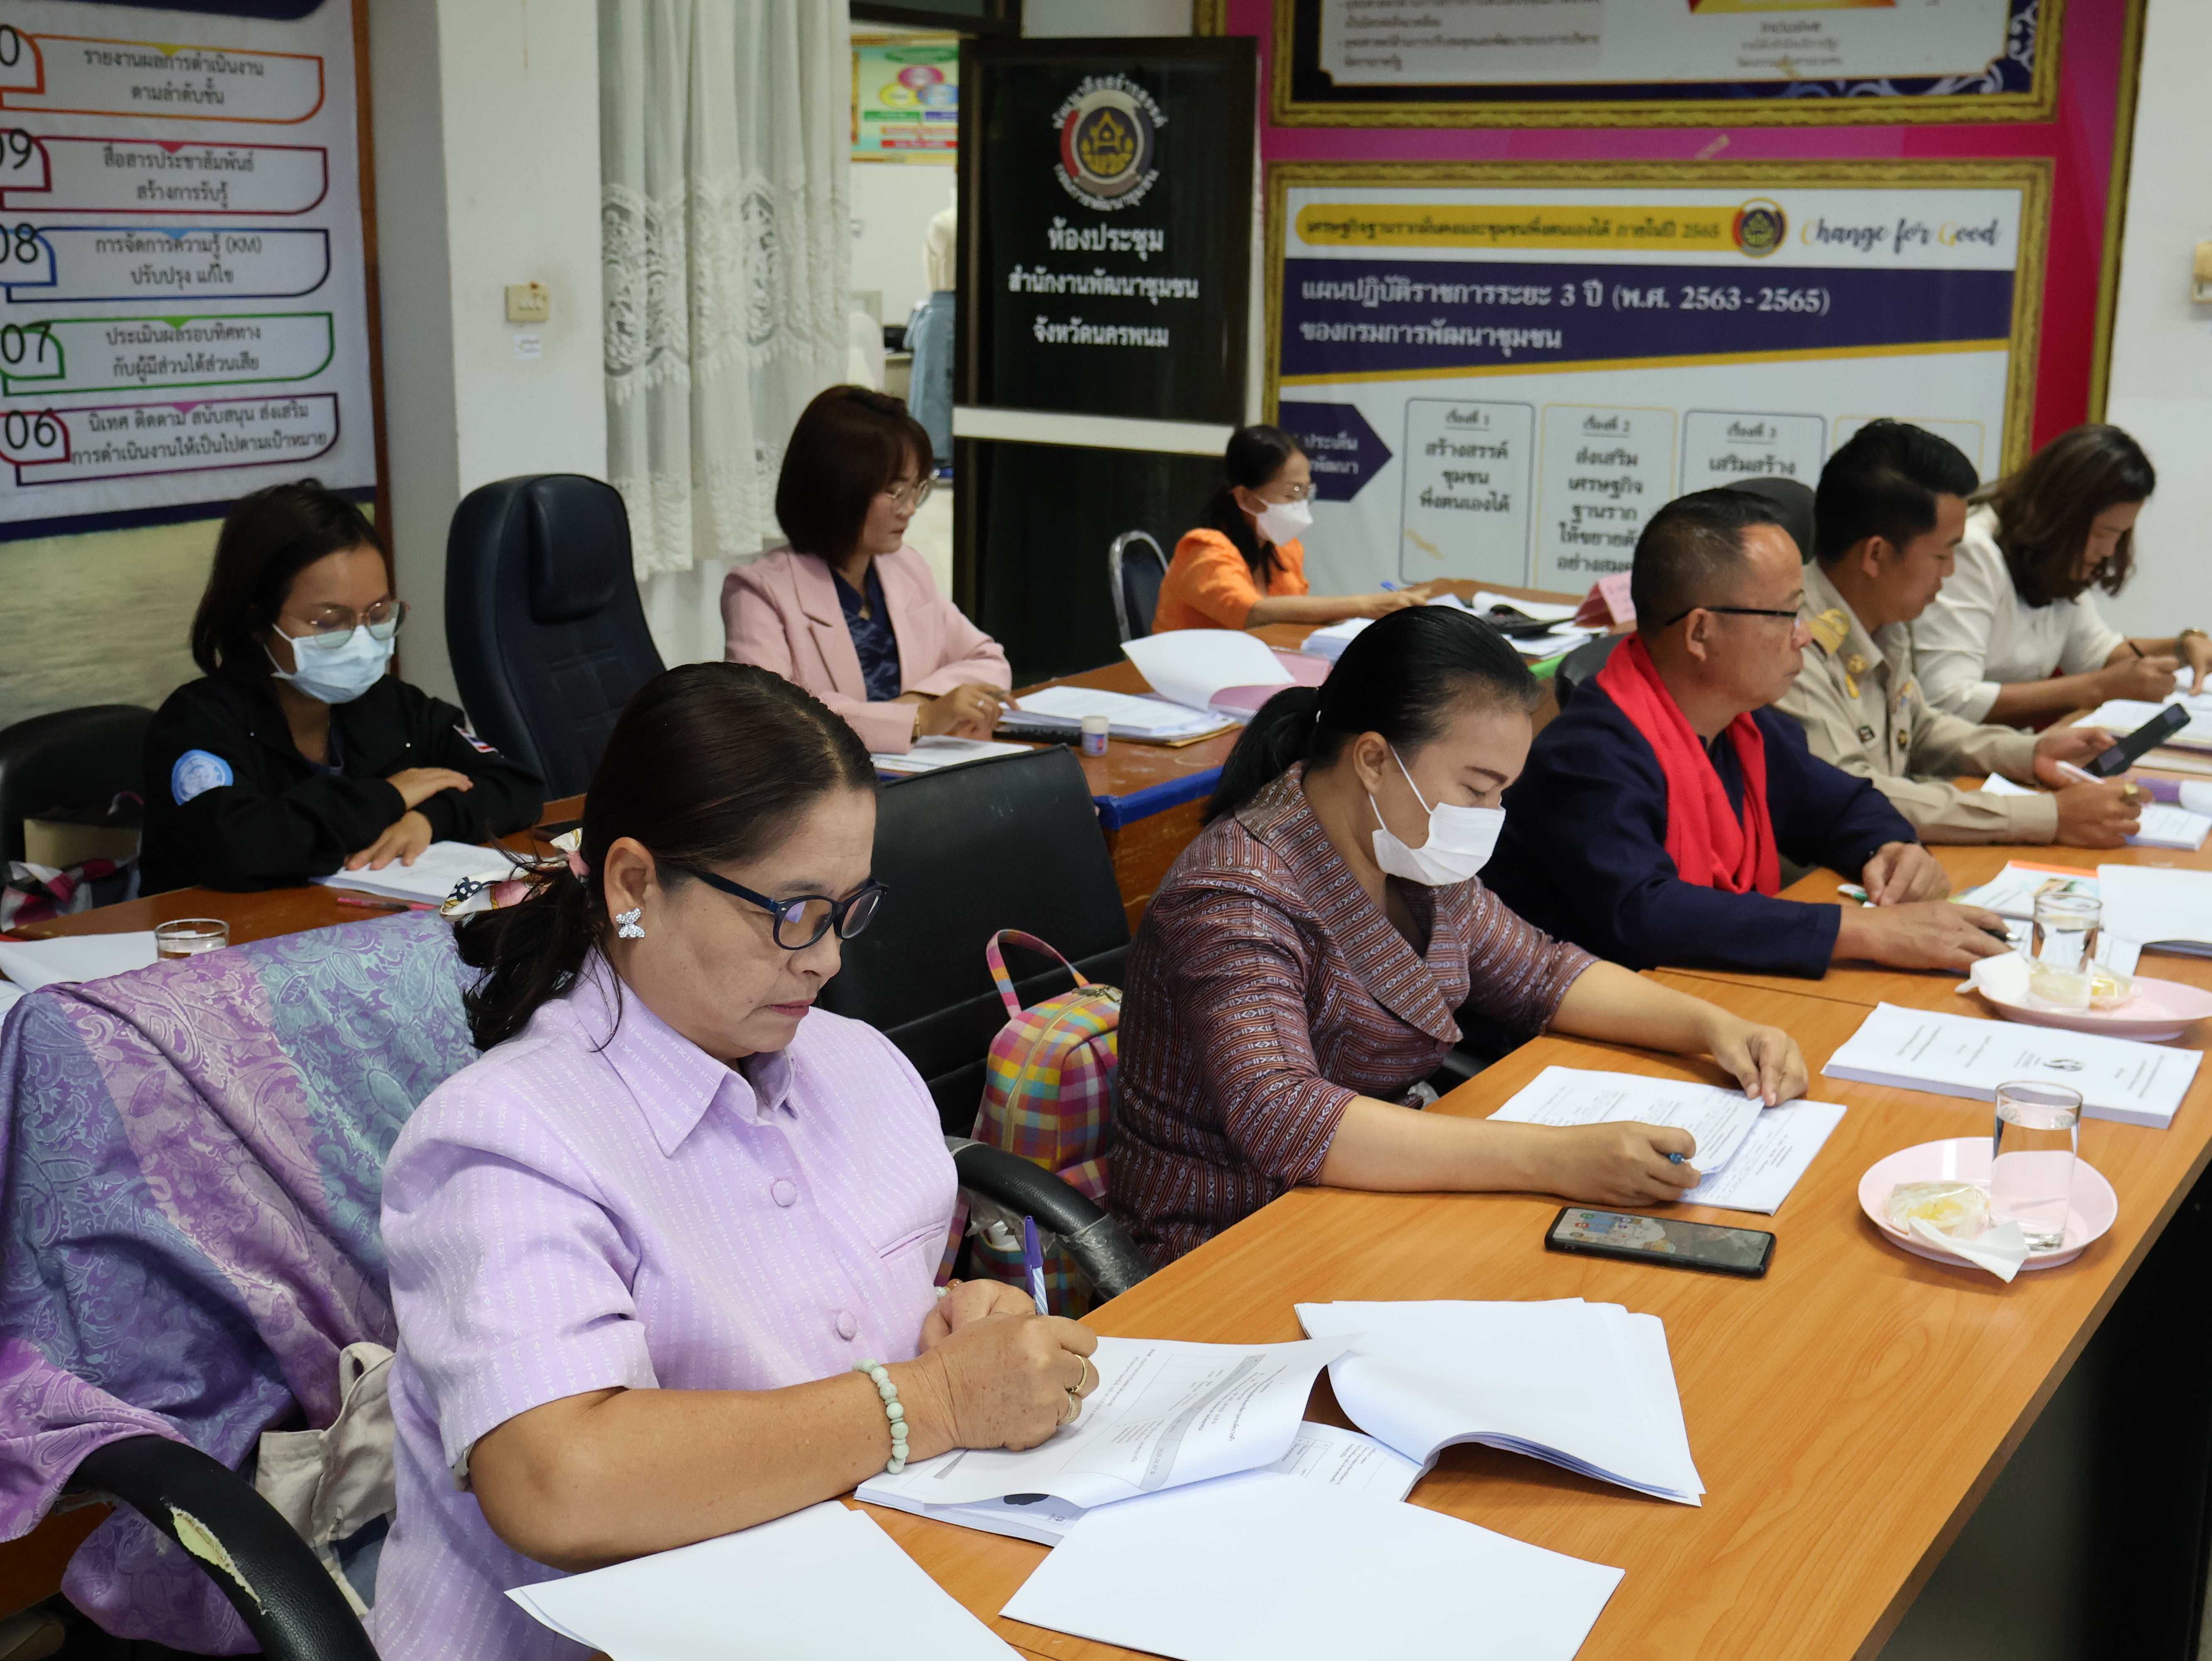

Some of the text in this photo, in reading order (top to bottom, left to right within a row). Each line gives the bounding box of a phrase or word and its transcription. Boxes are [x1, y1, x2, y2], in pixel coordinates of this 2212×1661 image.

[83, 49, 264, 76] รายงานผลการดำเนินงาน
[131, 77, 225, 105] ตามลำดับขั้น
[0, 128, 32, 170] 9
[103, 142, 255, 172] สื่อสารประชาสัมพันธ์
[137, 179, 228, 209] สร้างการรับรู้
[95, 232, 262, 261] การจัดการความรู้ (KM)
[1047, 215, 1165, 262] ห้องประชุม
[1801, 217, 1999, 254] Change for Good
[131, 262, 234, 291] ปรับปรุง แก้ไข
[1008, 263, 1200, 306] สำนักงานพัฒนาชุมชน
[1301, 274, 1552, 309] แผนปฏิบัติราชการระยะ
[1559, 282, 1576, 308] 3
[1582, 278, 1604, 308] ปี
[1611, 282, 1671, 313] (พ.ศ.
[1, 322, 52, 364] 07
[1033, 314, 1170, 348] จังหวัดนครพนม
[1299, 317, 1563, 358] ของกรมการพัฒนาชุมชน
[113, 351, 260, 383] กับผู้มีส่วนได้ส่วนเสีย
[5, 408, 57, 450] 06
[89, 413, 130, 432] นิเทศ
[191, 405, 255, 430] สนับสนุน
[259, 400, 309, 420] ส่งเสริม
[71, 428, 328, 465] การดำเนินงานให้เป็นไปตามเป้าหมาย
[1425, 437, 1510, 459] สร้างสรรค์
[1576, 446, 1639, 467] ส่งเสริม
[1709, 454, 1797, 475] เสริมสร้าง
[1443, 470, 1490, 490] ชุมชน
[1568, 476, 1644, 499] เศรษฐกิจ
[1419, 485, 1511, 513] พึ่งตนเองได้
[1571, 504, 1638, 524] ฐานราก
